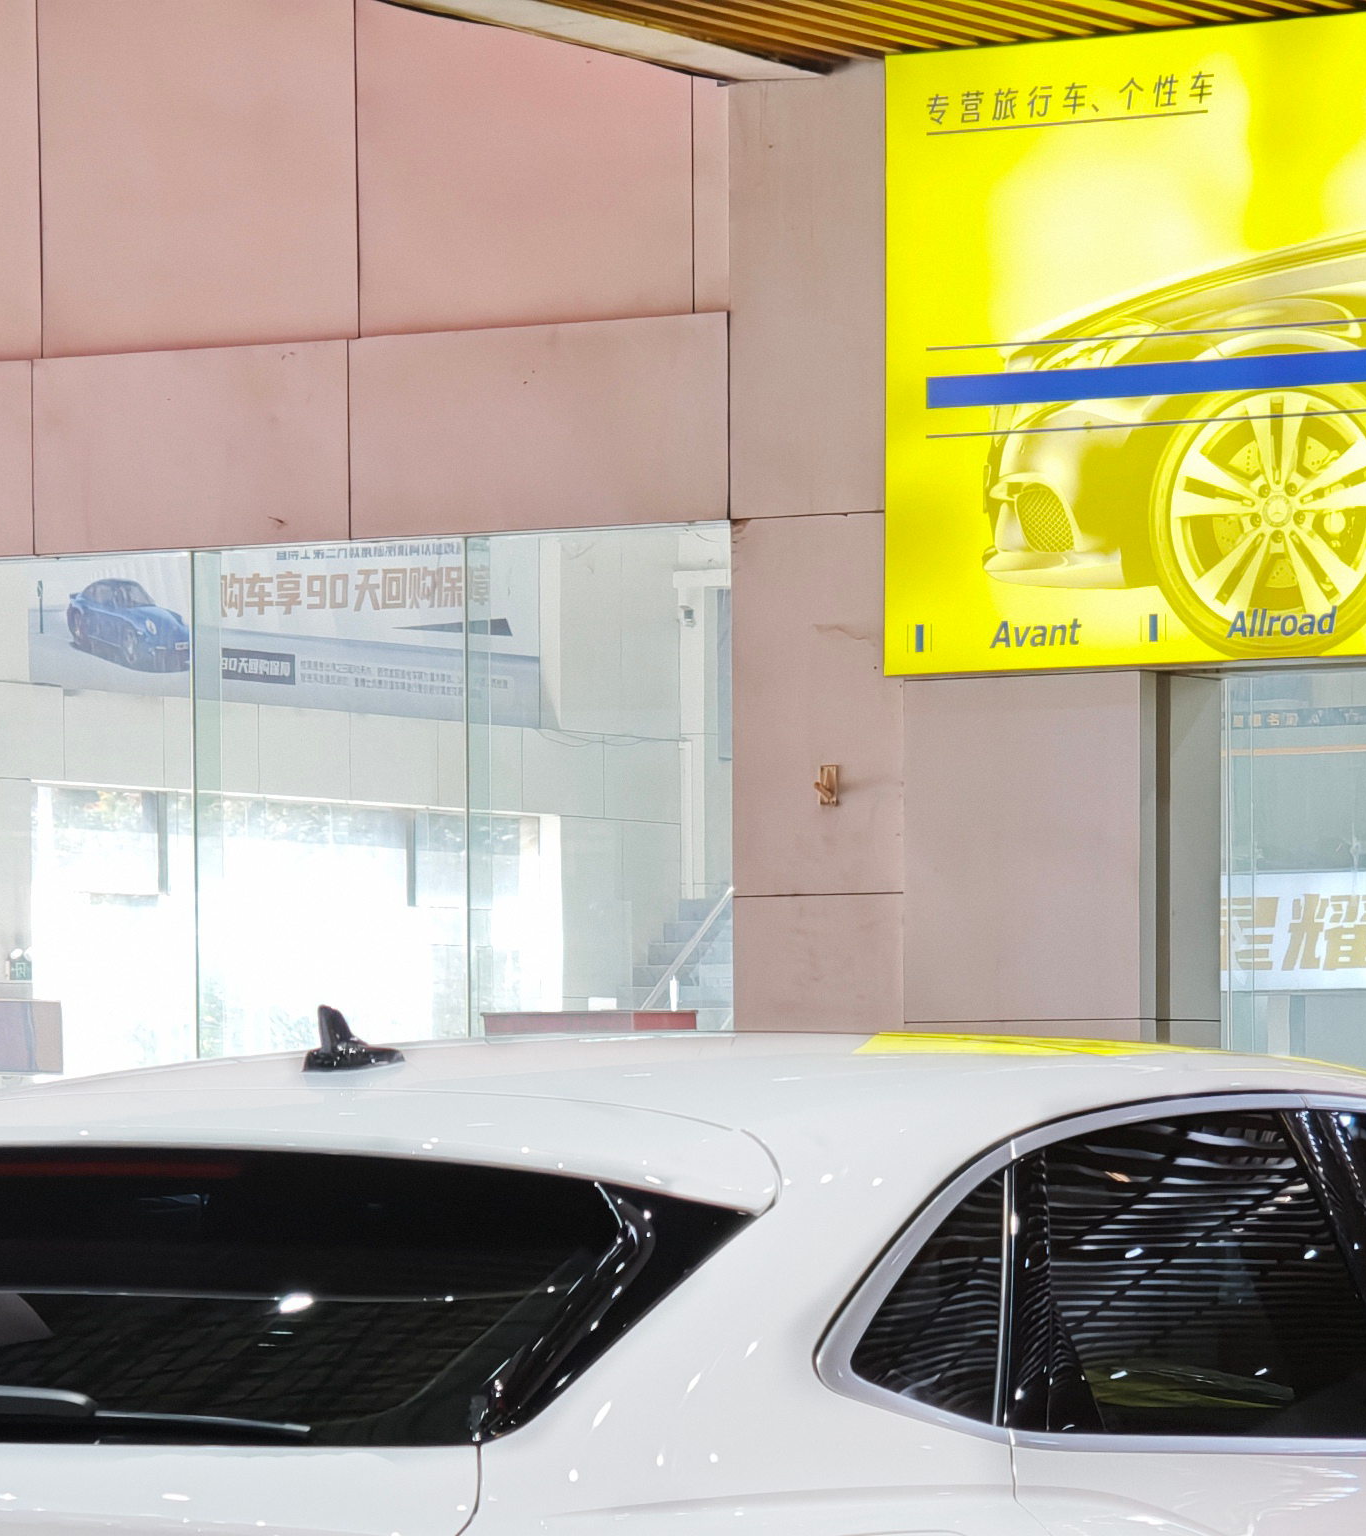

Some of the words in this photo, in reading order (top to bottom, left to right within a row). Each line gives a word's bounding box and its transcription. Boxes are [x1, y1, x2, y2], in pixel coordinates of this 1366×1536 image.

[926, 71, 1214, 125] 专营旅行车、个性车
[991, 617, 1081, 649] Avant
[1227, 606, 1337, 639] Allroad
